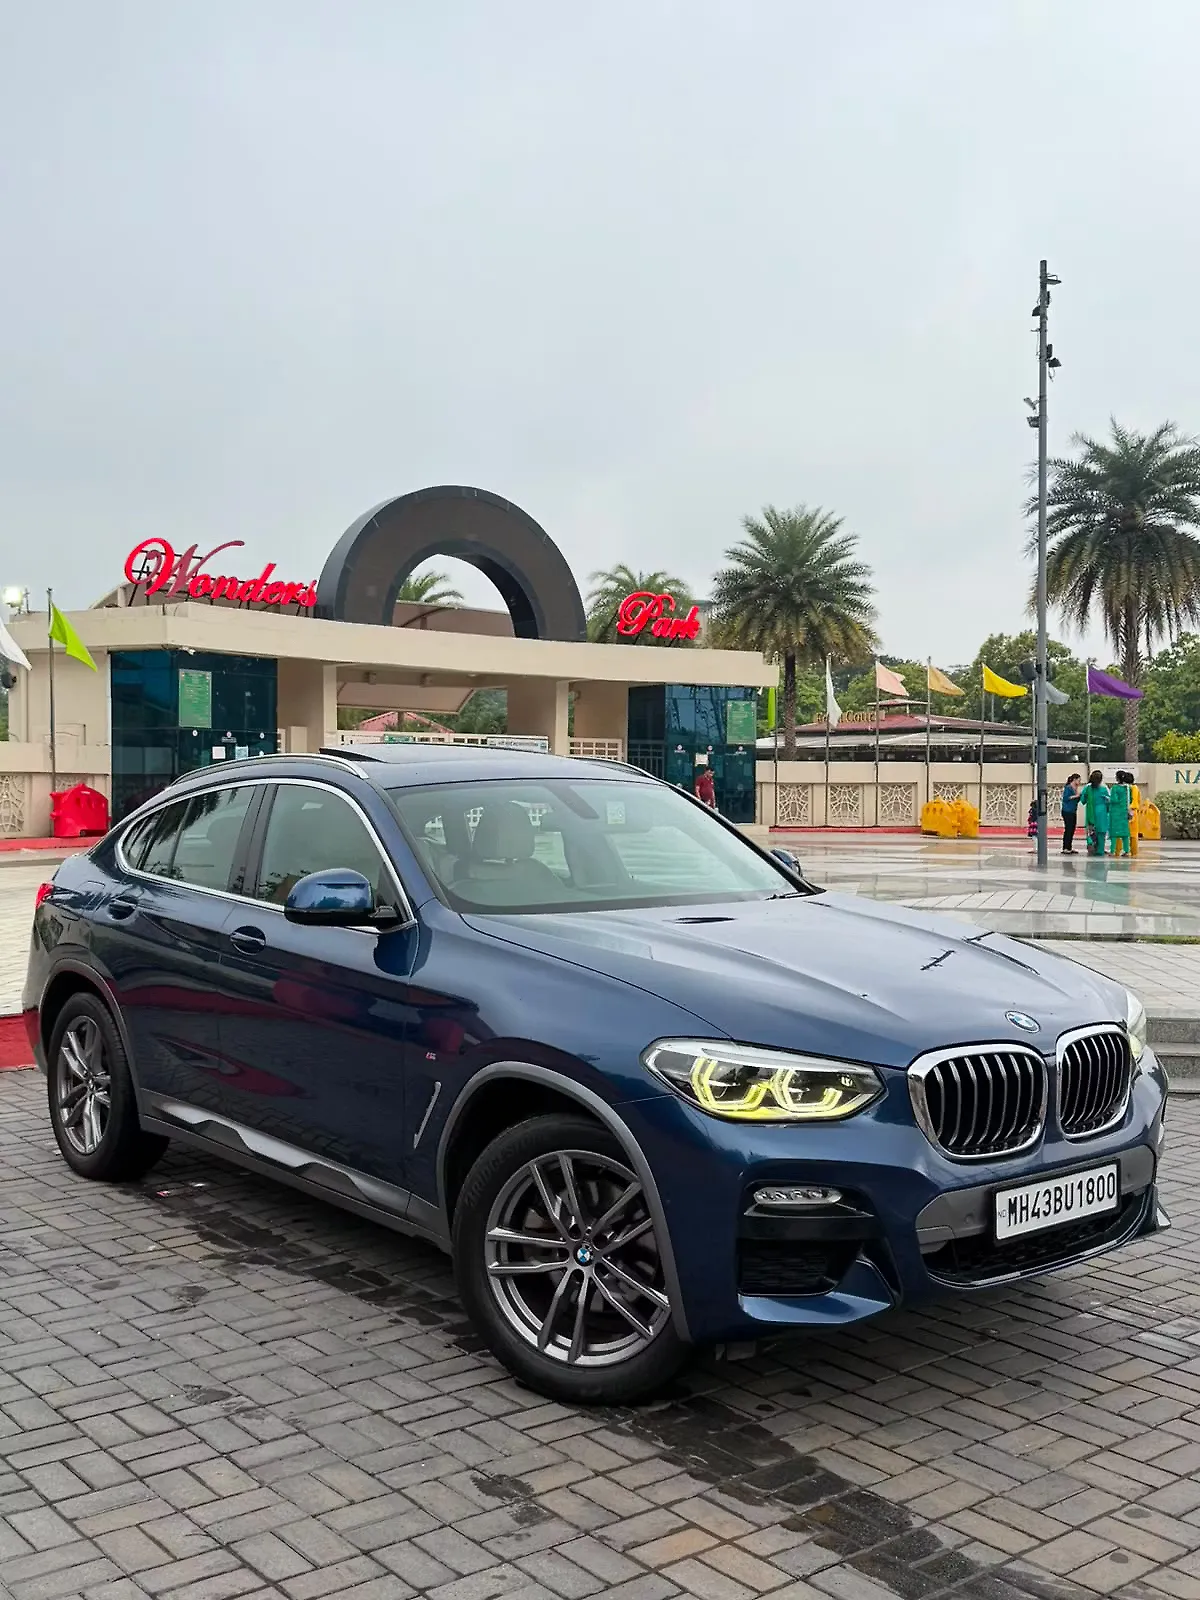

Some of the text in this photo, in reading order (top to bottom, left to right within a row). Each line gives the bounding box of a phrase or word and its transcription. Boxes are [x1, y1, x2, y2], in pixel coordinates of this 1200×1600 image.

[124, 537, 700, 640] Wonders Park
[1008, 1171, 1116, 1227] MH43BU1800
